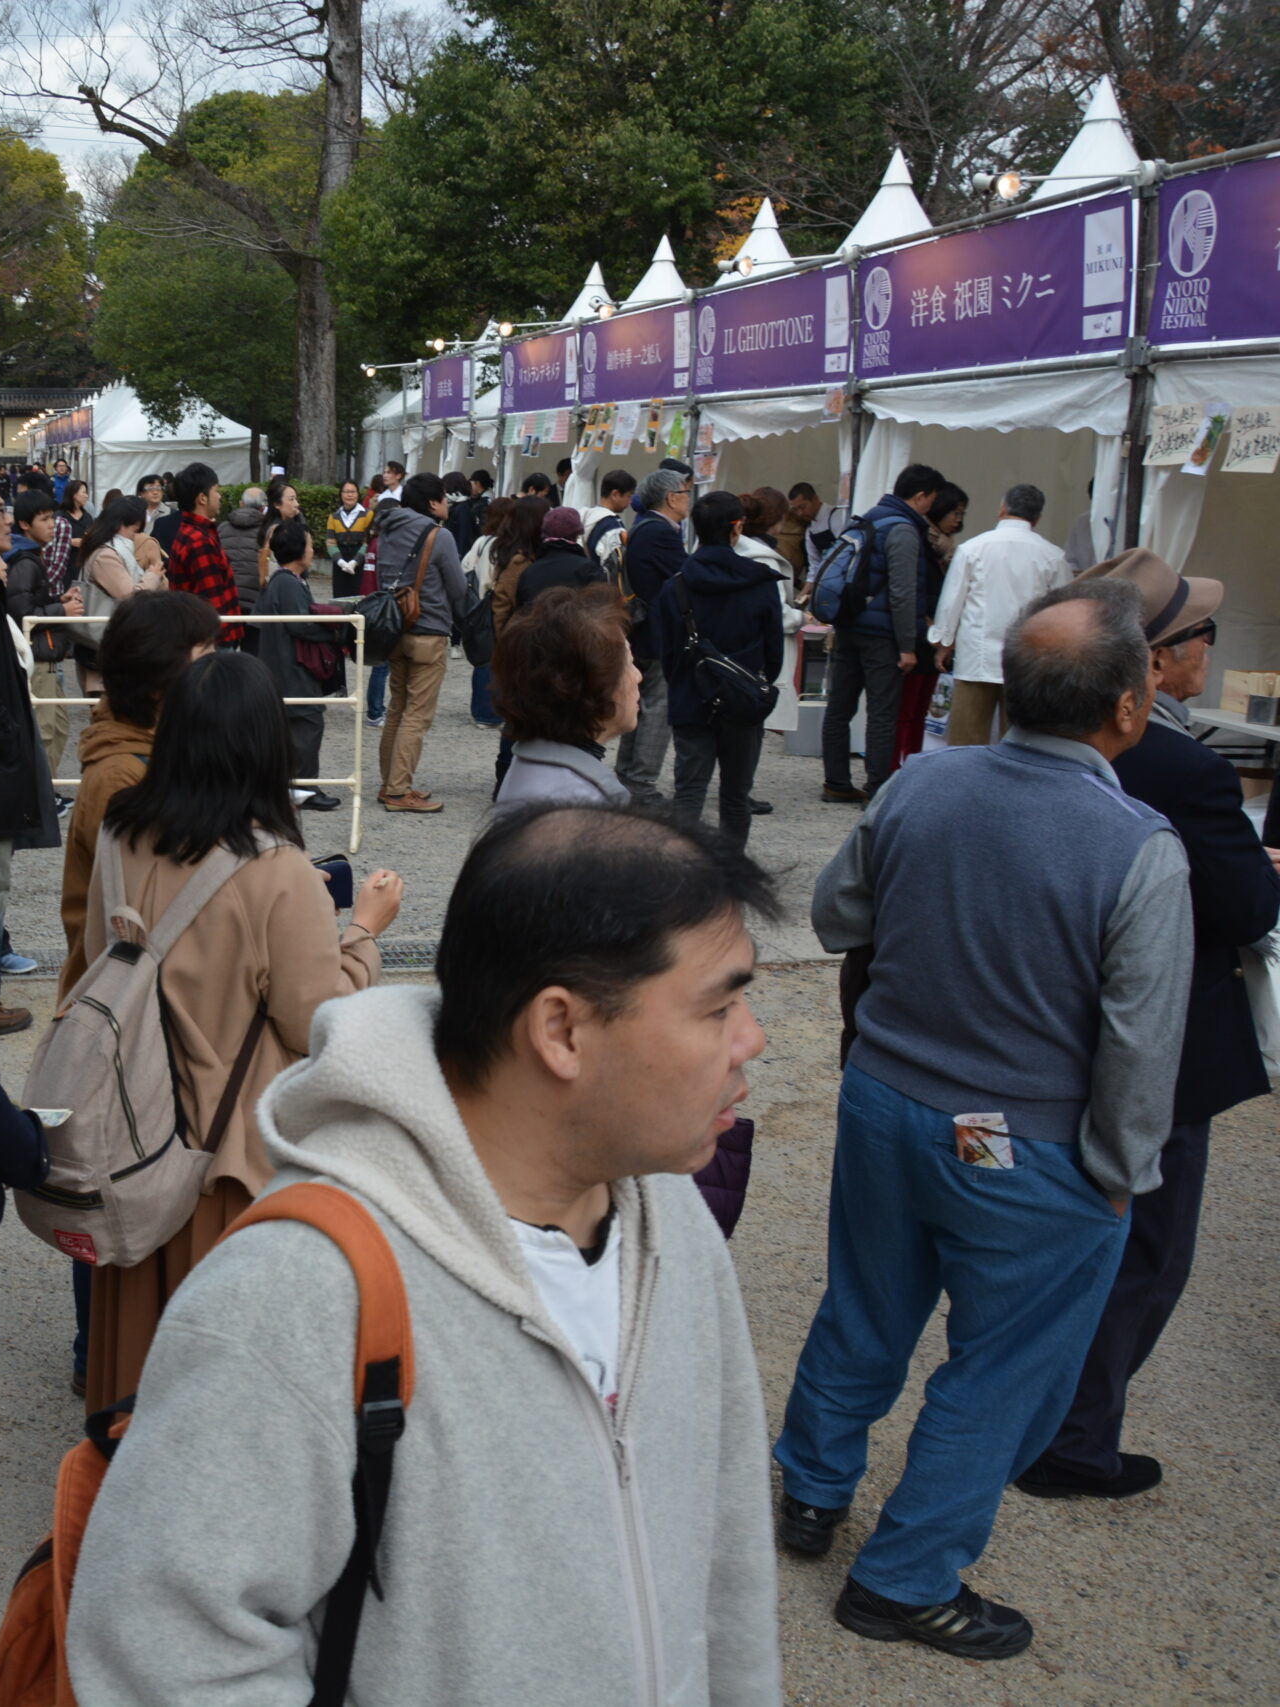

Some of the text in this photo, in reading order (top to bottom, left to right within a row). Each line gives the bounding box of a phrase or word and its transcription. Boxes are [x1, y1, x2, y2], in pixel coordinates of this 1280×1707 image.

[1085, 256, 1125, 274] MIKUNI
[1165, 277, 1211, 299] KYOTO
[911, 285, 947, 327] 洋食
[1001, 272, 1055, 309] ミクニ
[1162, 295, 1209, 315] NIPPON
[1160, 312, 1208, 329] FESTIVAL
[723, 328, 736, 354] IL
[737, 315, 814, 353] GHIOTTONE
